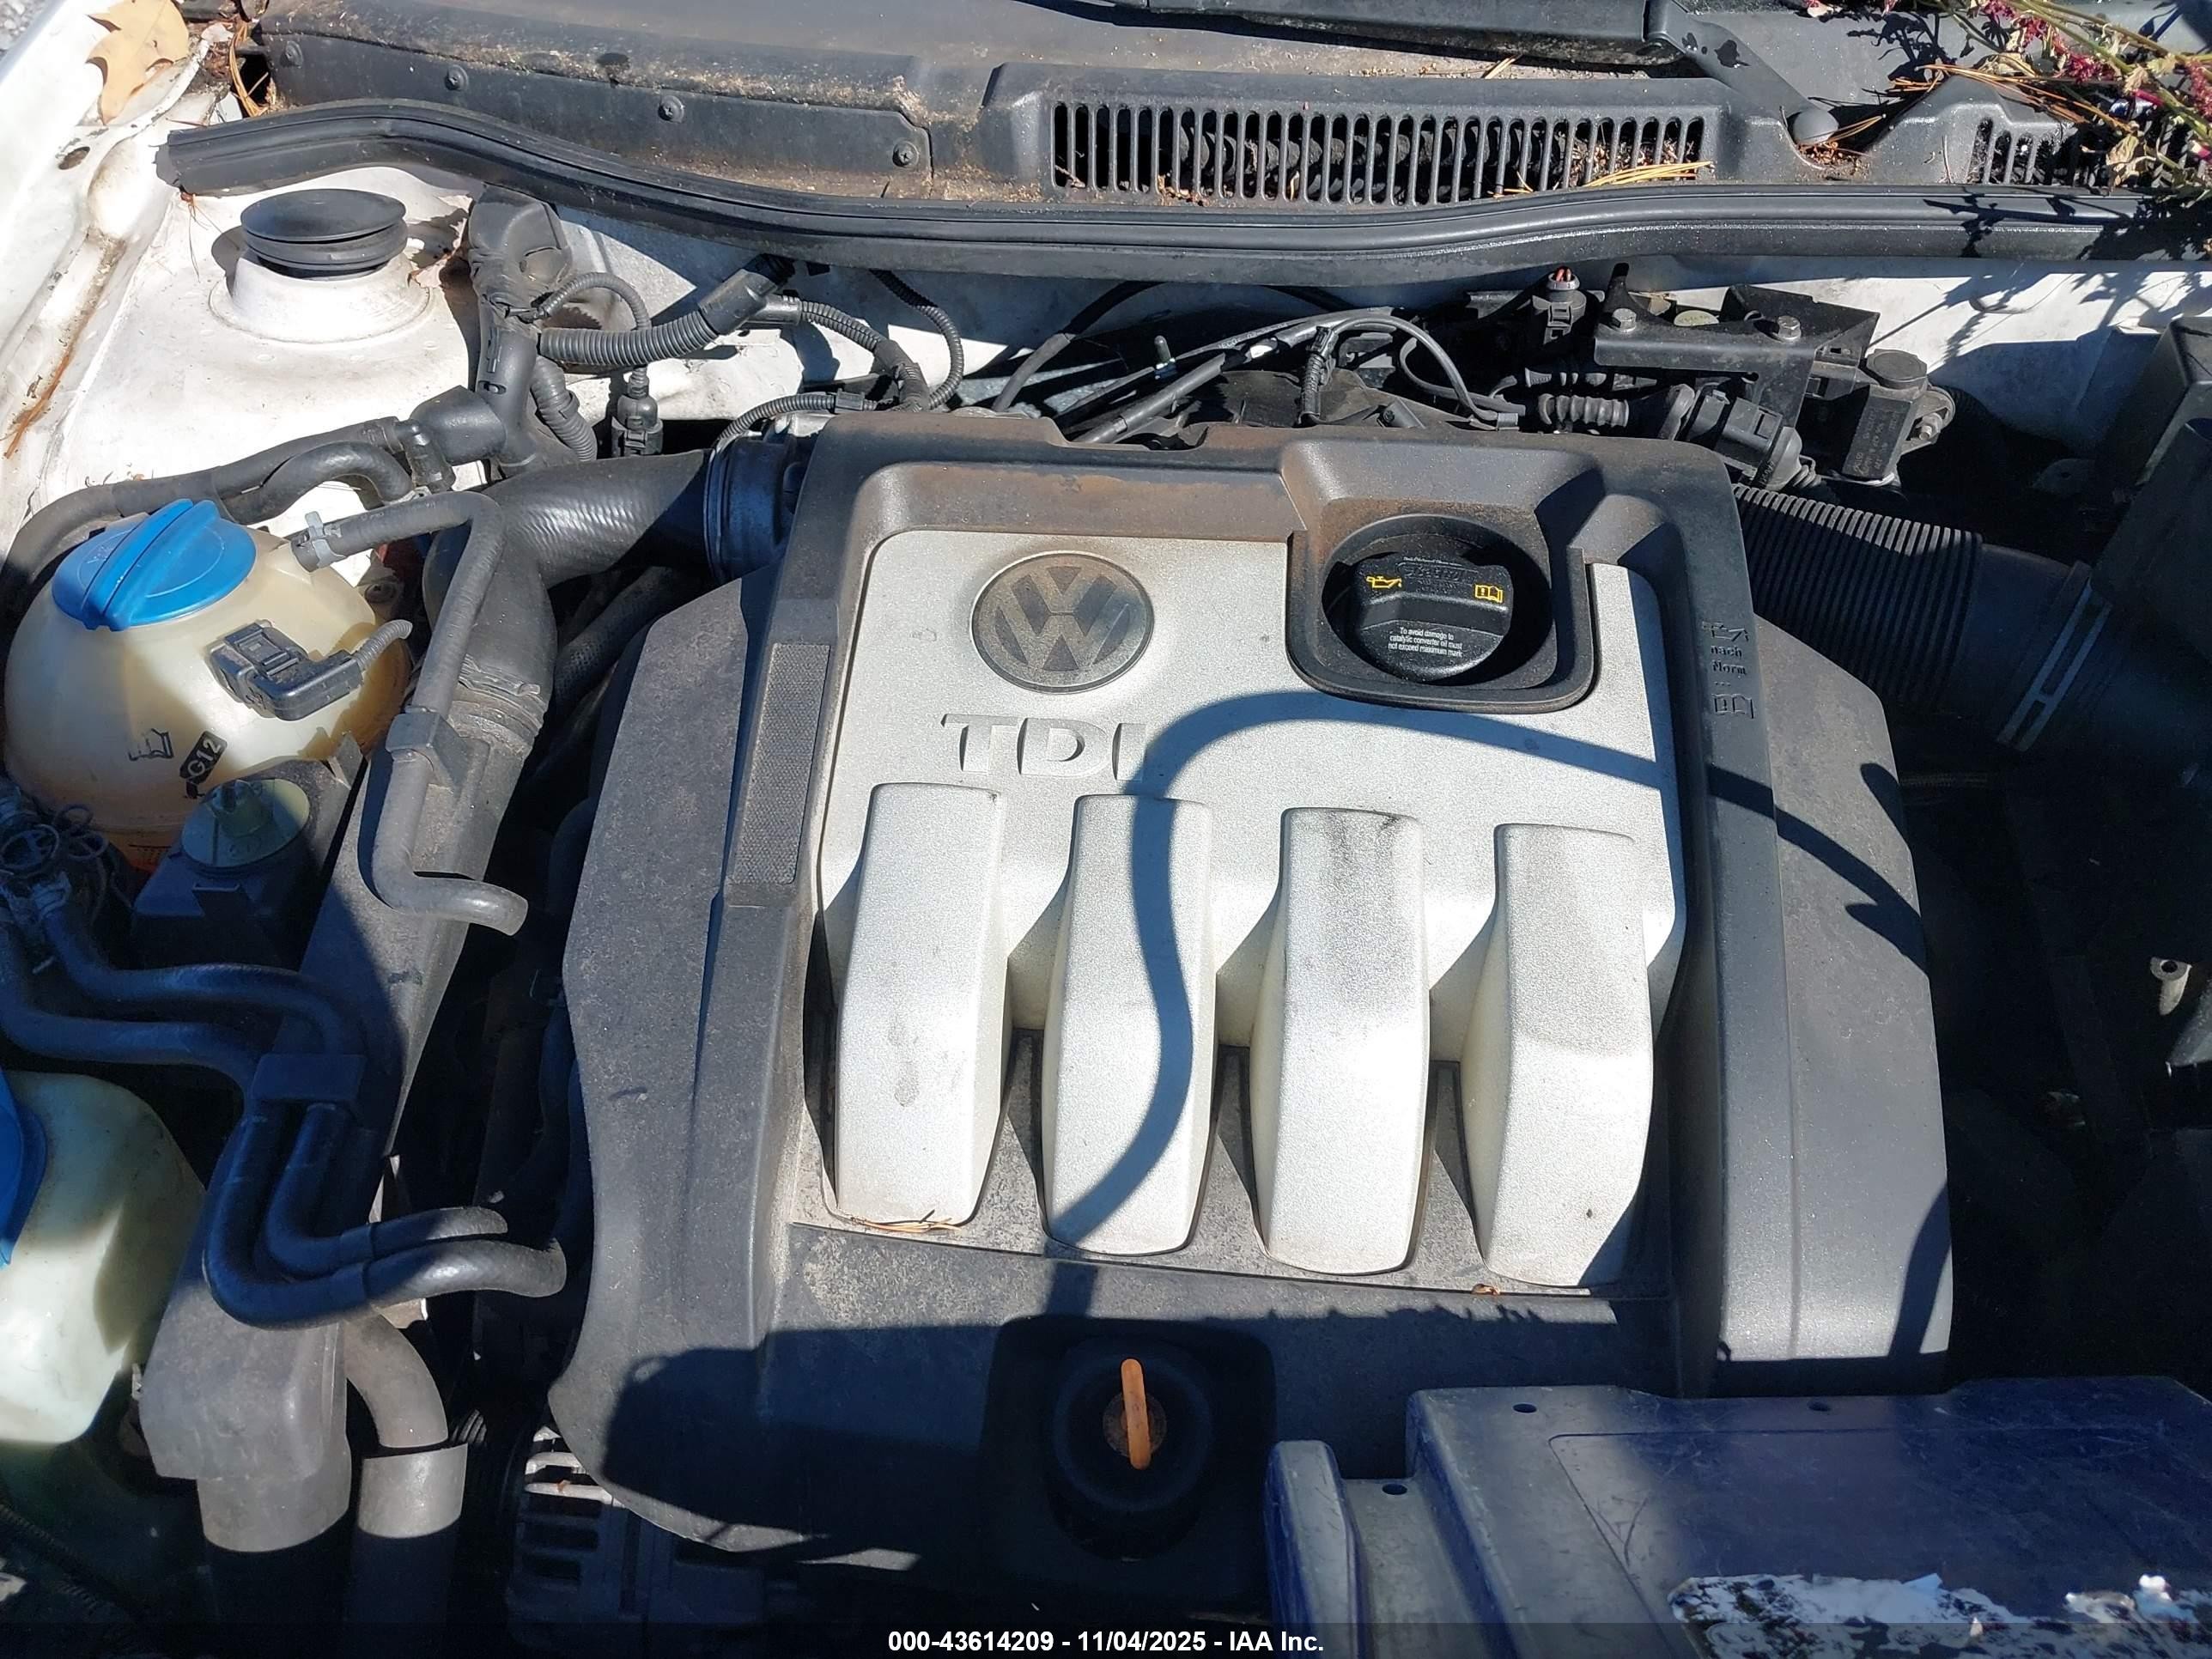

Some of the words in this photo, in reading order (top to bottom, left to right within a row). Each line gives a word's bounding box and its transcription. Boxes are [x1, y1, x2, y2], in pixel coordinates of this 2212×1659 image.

[1408, 628, 1424, 636] avoid
[1425, 630, 1448, 641] damage
[1389, 635, 1413, 644] catalytic
[1413, 637, 1440, 646] converter
[1448, 641, 1463, 650] must
[1398, 643, 1419, 652] exceed
[1419, 645, 1448, 655] maximum
[1711, 646, 1742, 659] nach
[940, 713, 1148, 782] TDI
[187, 738, 222, 776] G12
